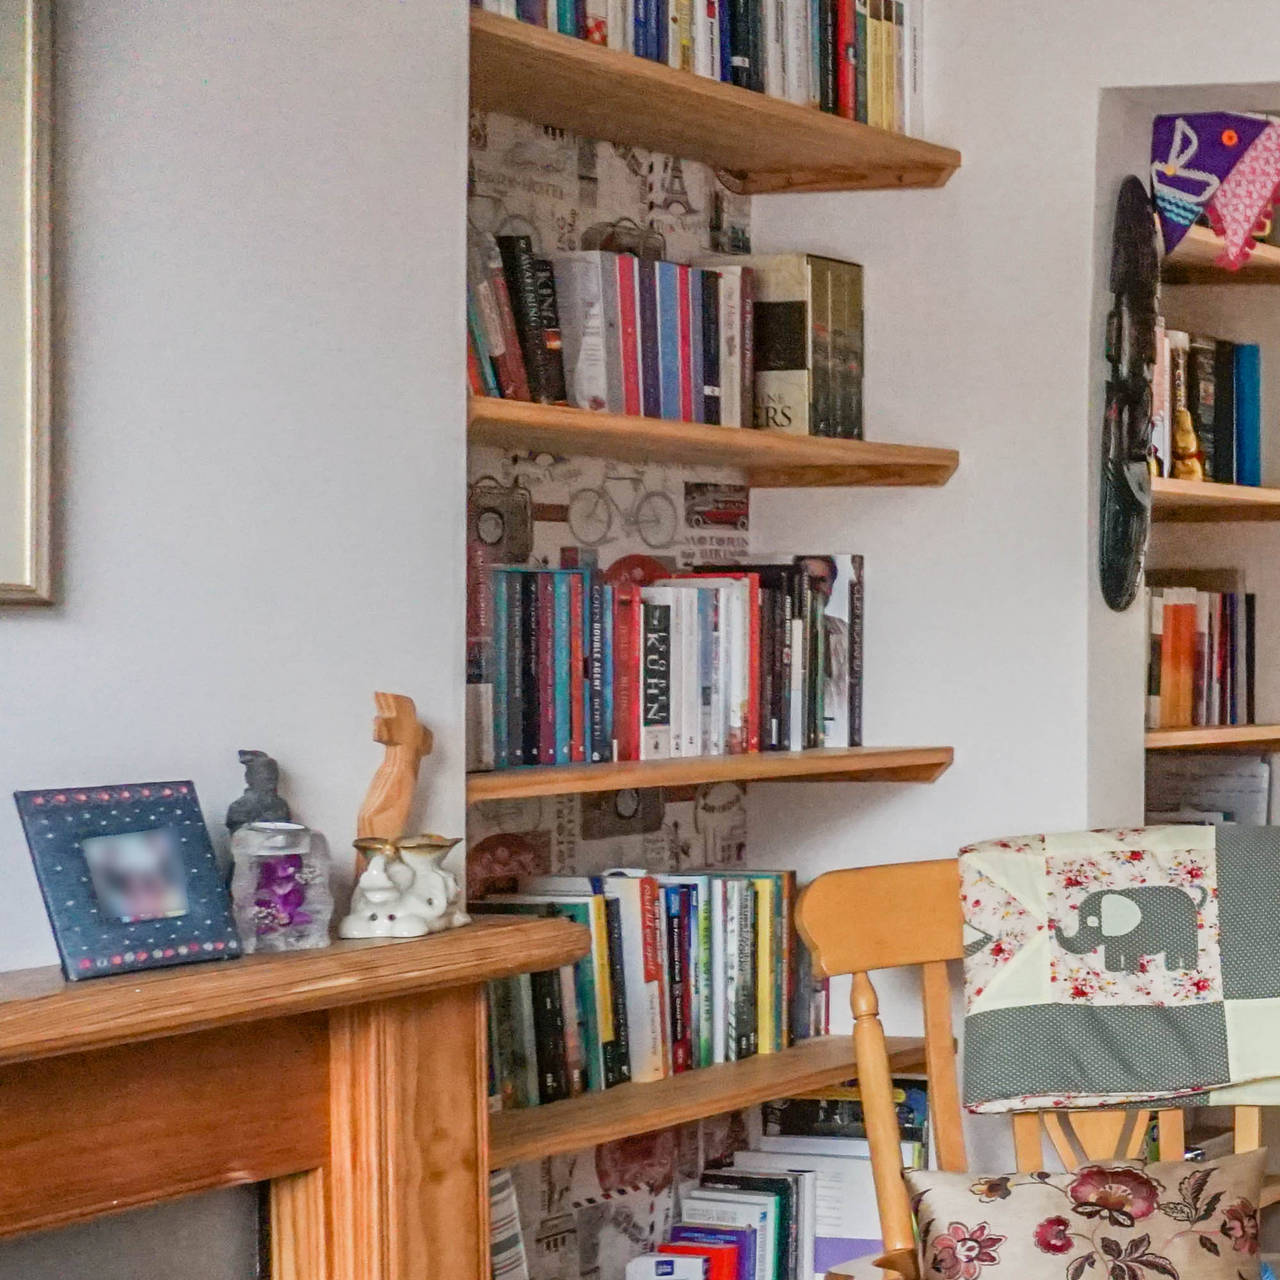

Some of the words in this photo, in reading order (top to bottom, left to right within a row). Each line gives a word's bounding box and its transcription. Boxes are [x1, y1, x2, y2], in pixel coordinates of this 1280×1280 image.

[592, 622, 602, 660] DOUBLE
[592, 661, 602, 690] AGENT
[647, 633, 661, 720] KUHN
